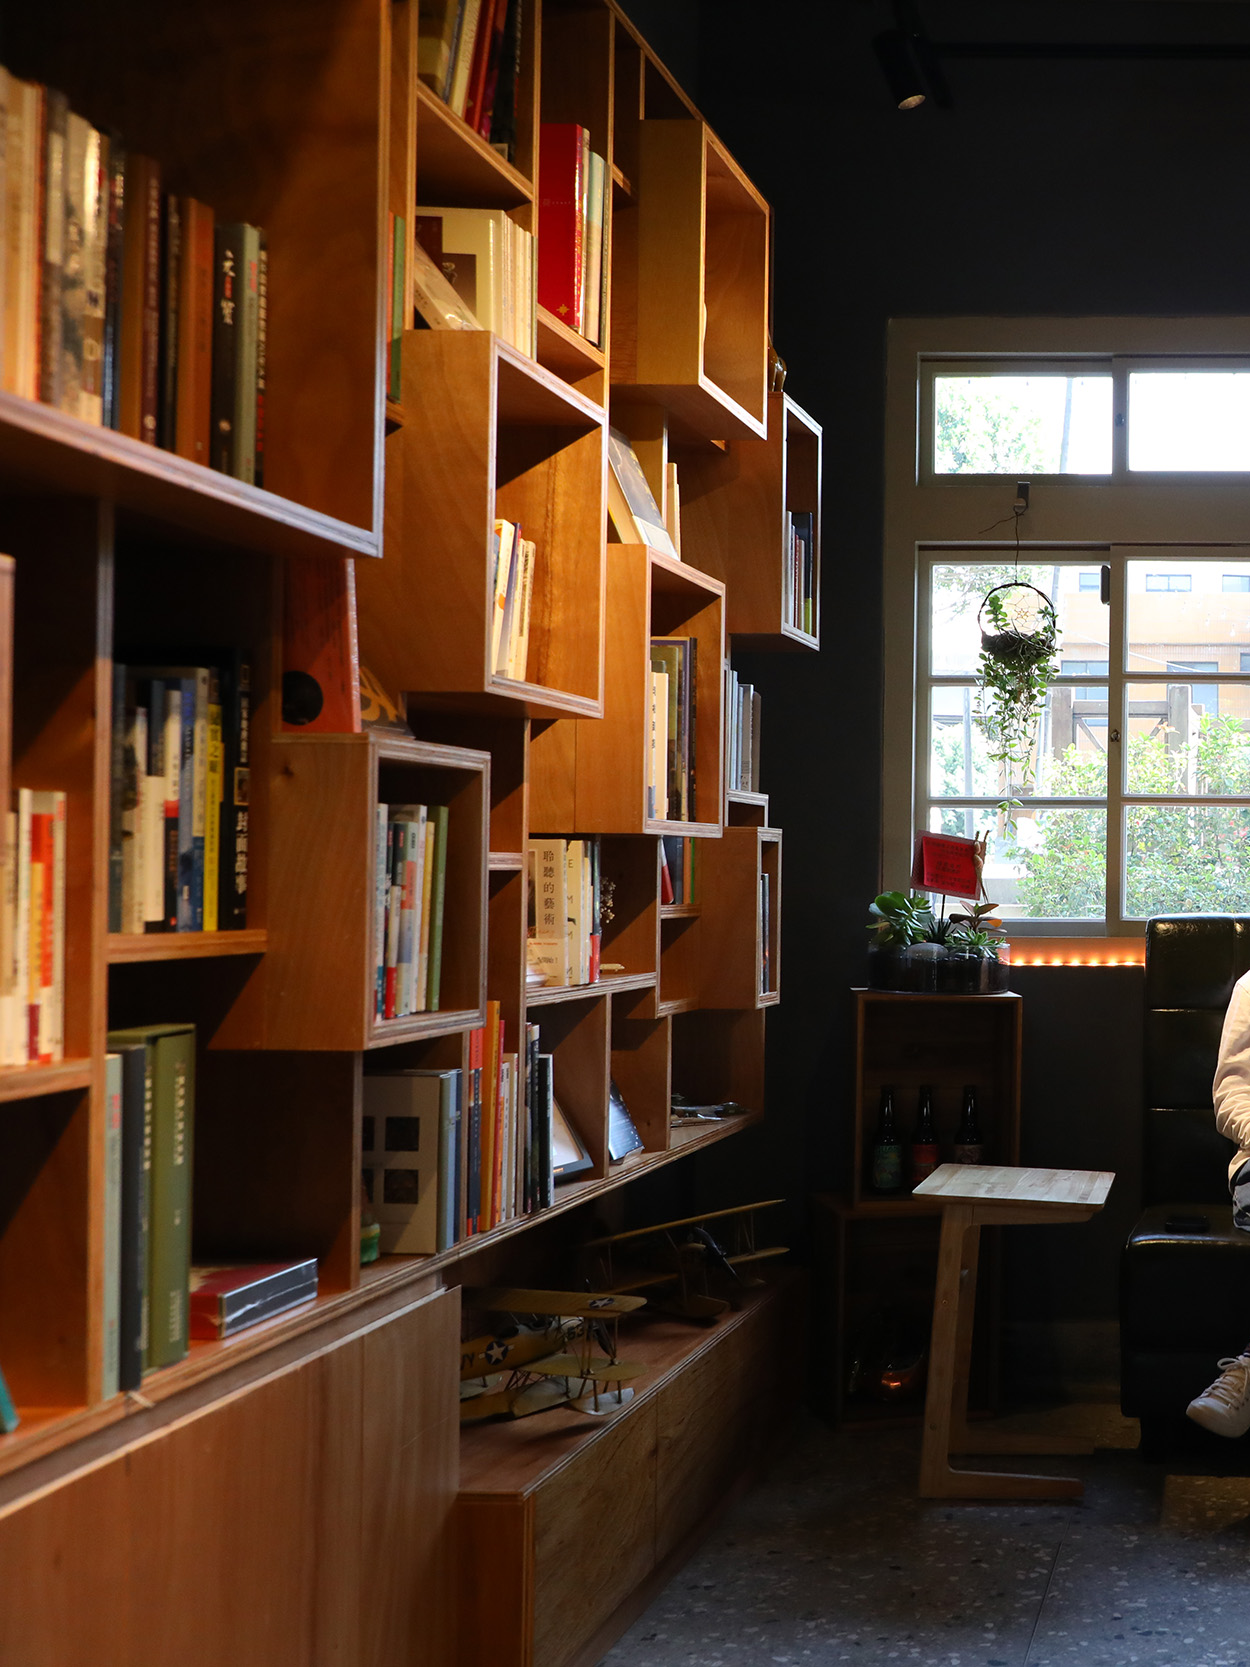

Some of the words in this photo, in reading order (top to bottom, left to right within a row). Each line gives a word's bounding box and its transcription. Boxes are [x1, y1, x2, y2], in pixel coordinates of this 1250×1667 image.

[543, 850, 555, 925] 聆聽的藝術
